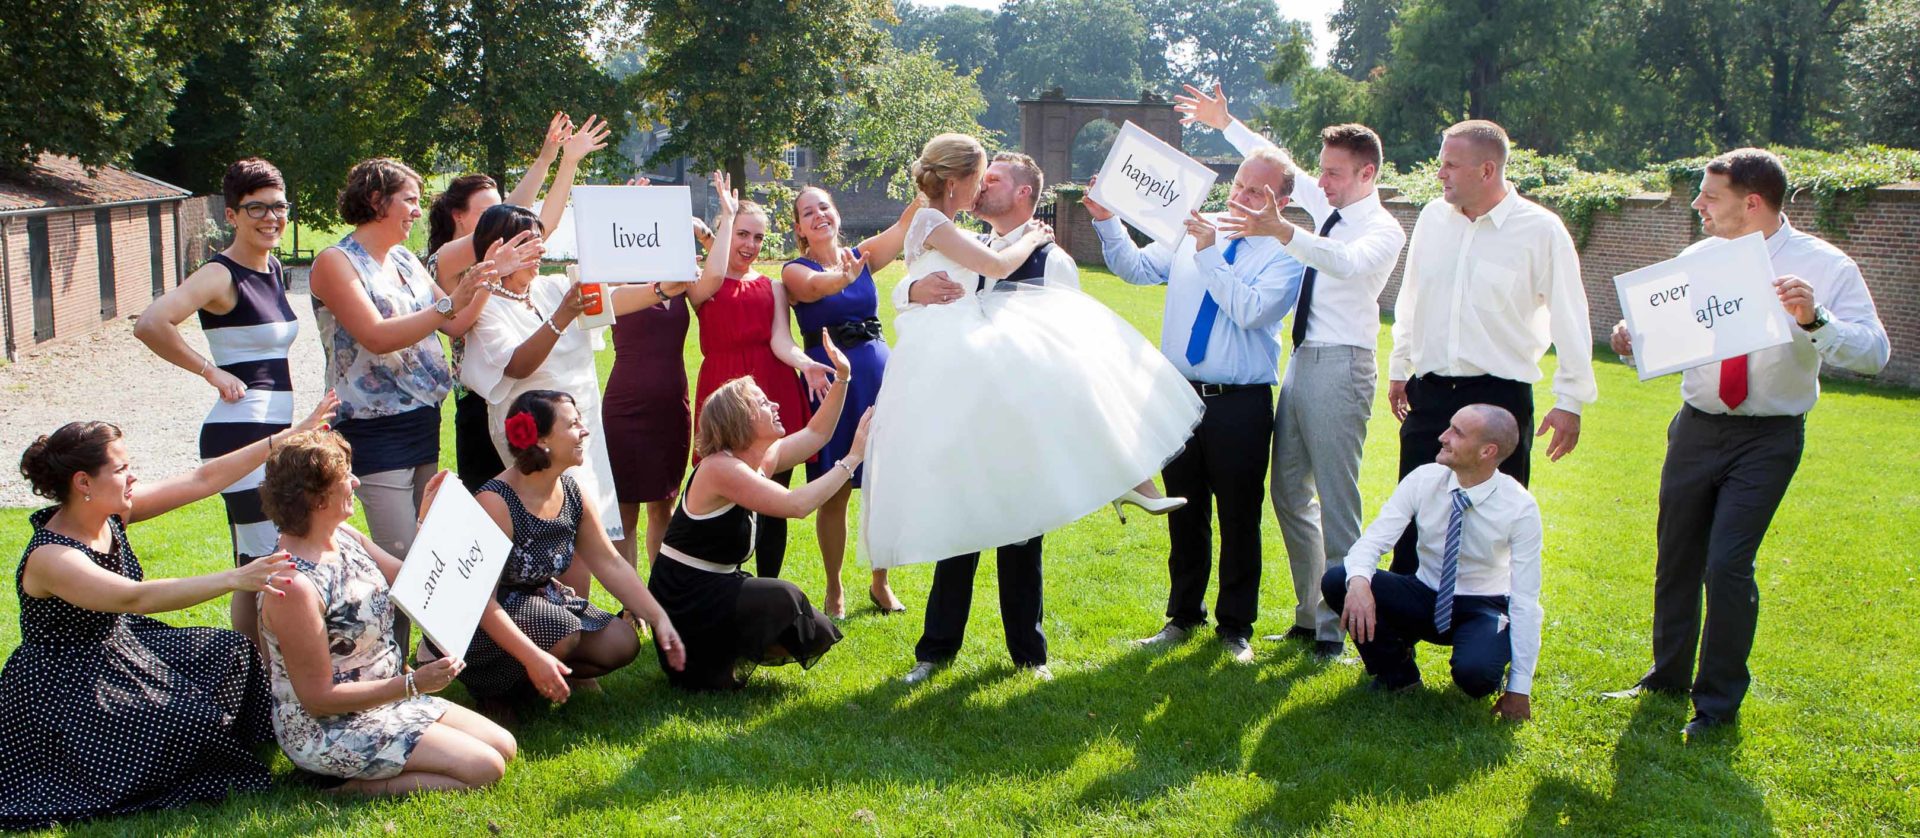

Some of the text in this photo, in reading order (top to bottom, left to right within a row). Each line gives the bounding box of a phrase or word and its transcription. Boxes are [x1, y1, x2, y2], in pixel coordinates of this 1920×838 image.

[1120, 153, 1181, 207] happily
[612, 221, 661, 248] lived
[1650, 284, 1690, 307] ever
[1696, 295, 1743, 329] after
[457, 539, 485, 580] they
